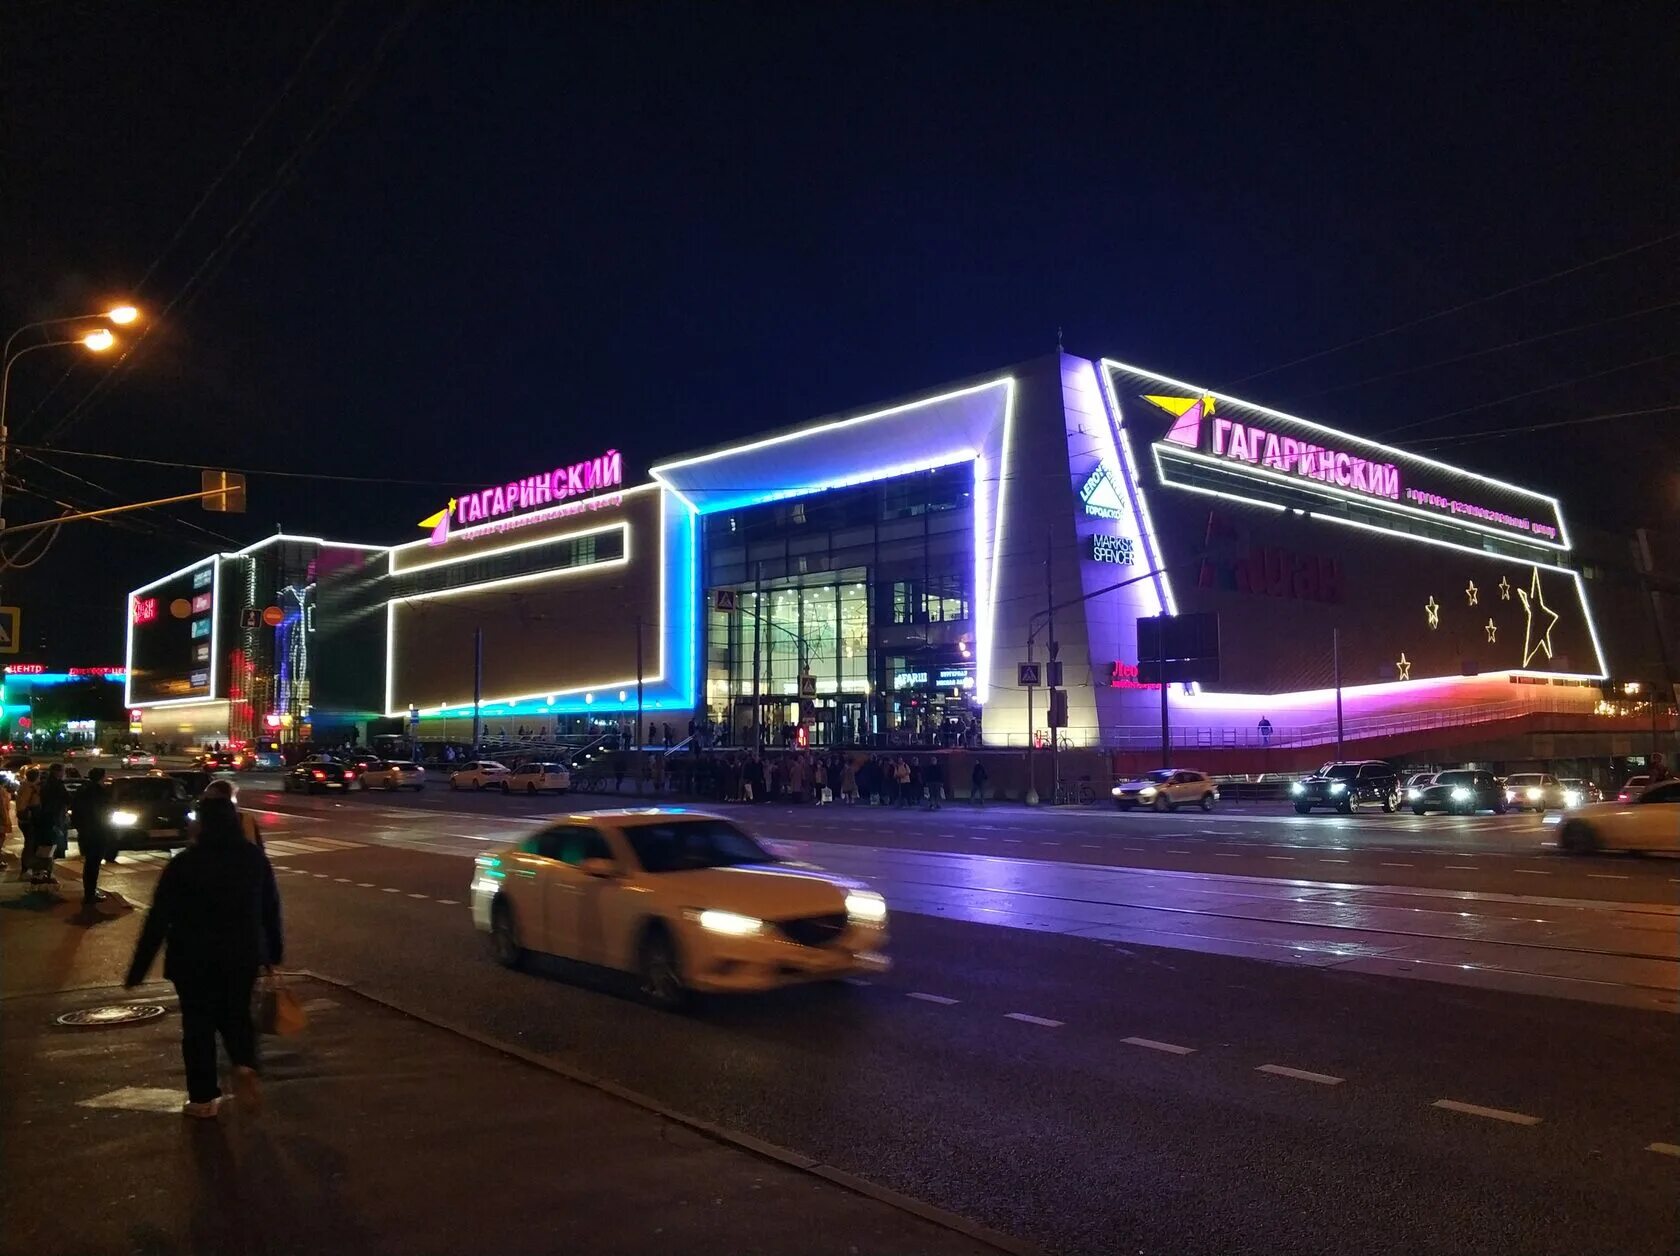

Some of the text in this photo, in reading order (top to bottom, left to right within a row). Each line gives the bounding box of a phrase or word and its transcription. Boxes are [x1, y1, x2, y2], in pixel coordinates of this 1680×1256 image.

[1212, 417, 1399, 500] ГАГАРИНСКИЙ
[457, 448, 622, 524] ГАГАРИНСКИЙ
[1080, 464, 1104, 502] LEROY
[1085, 504, 1123, 519] ГОРОДСКО
[1093, 547, 1135, 566] SPENCER
[10, 665, 42, 674] ЦЕНТР
